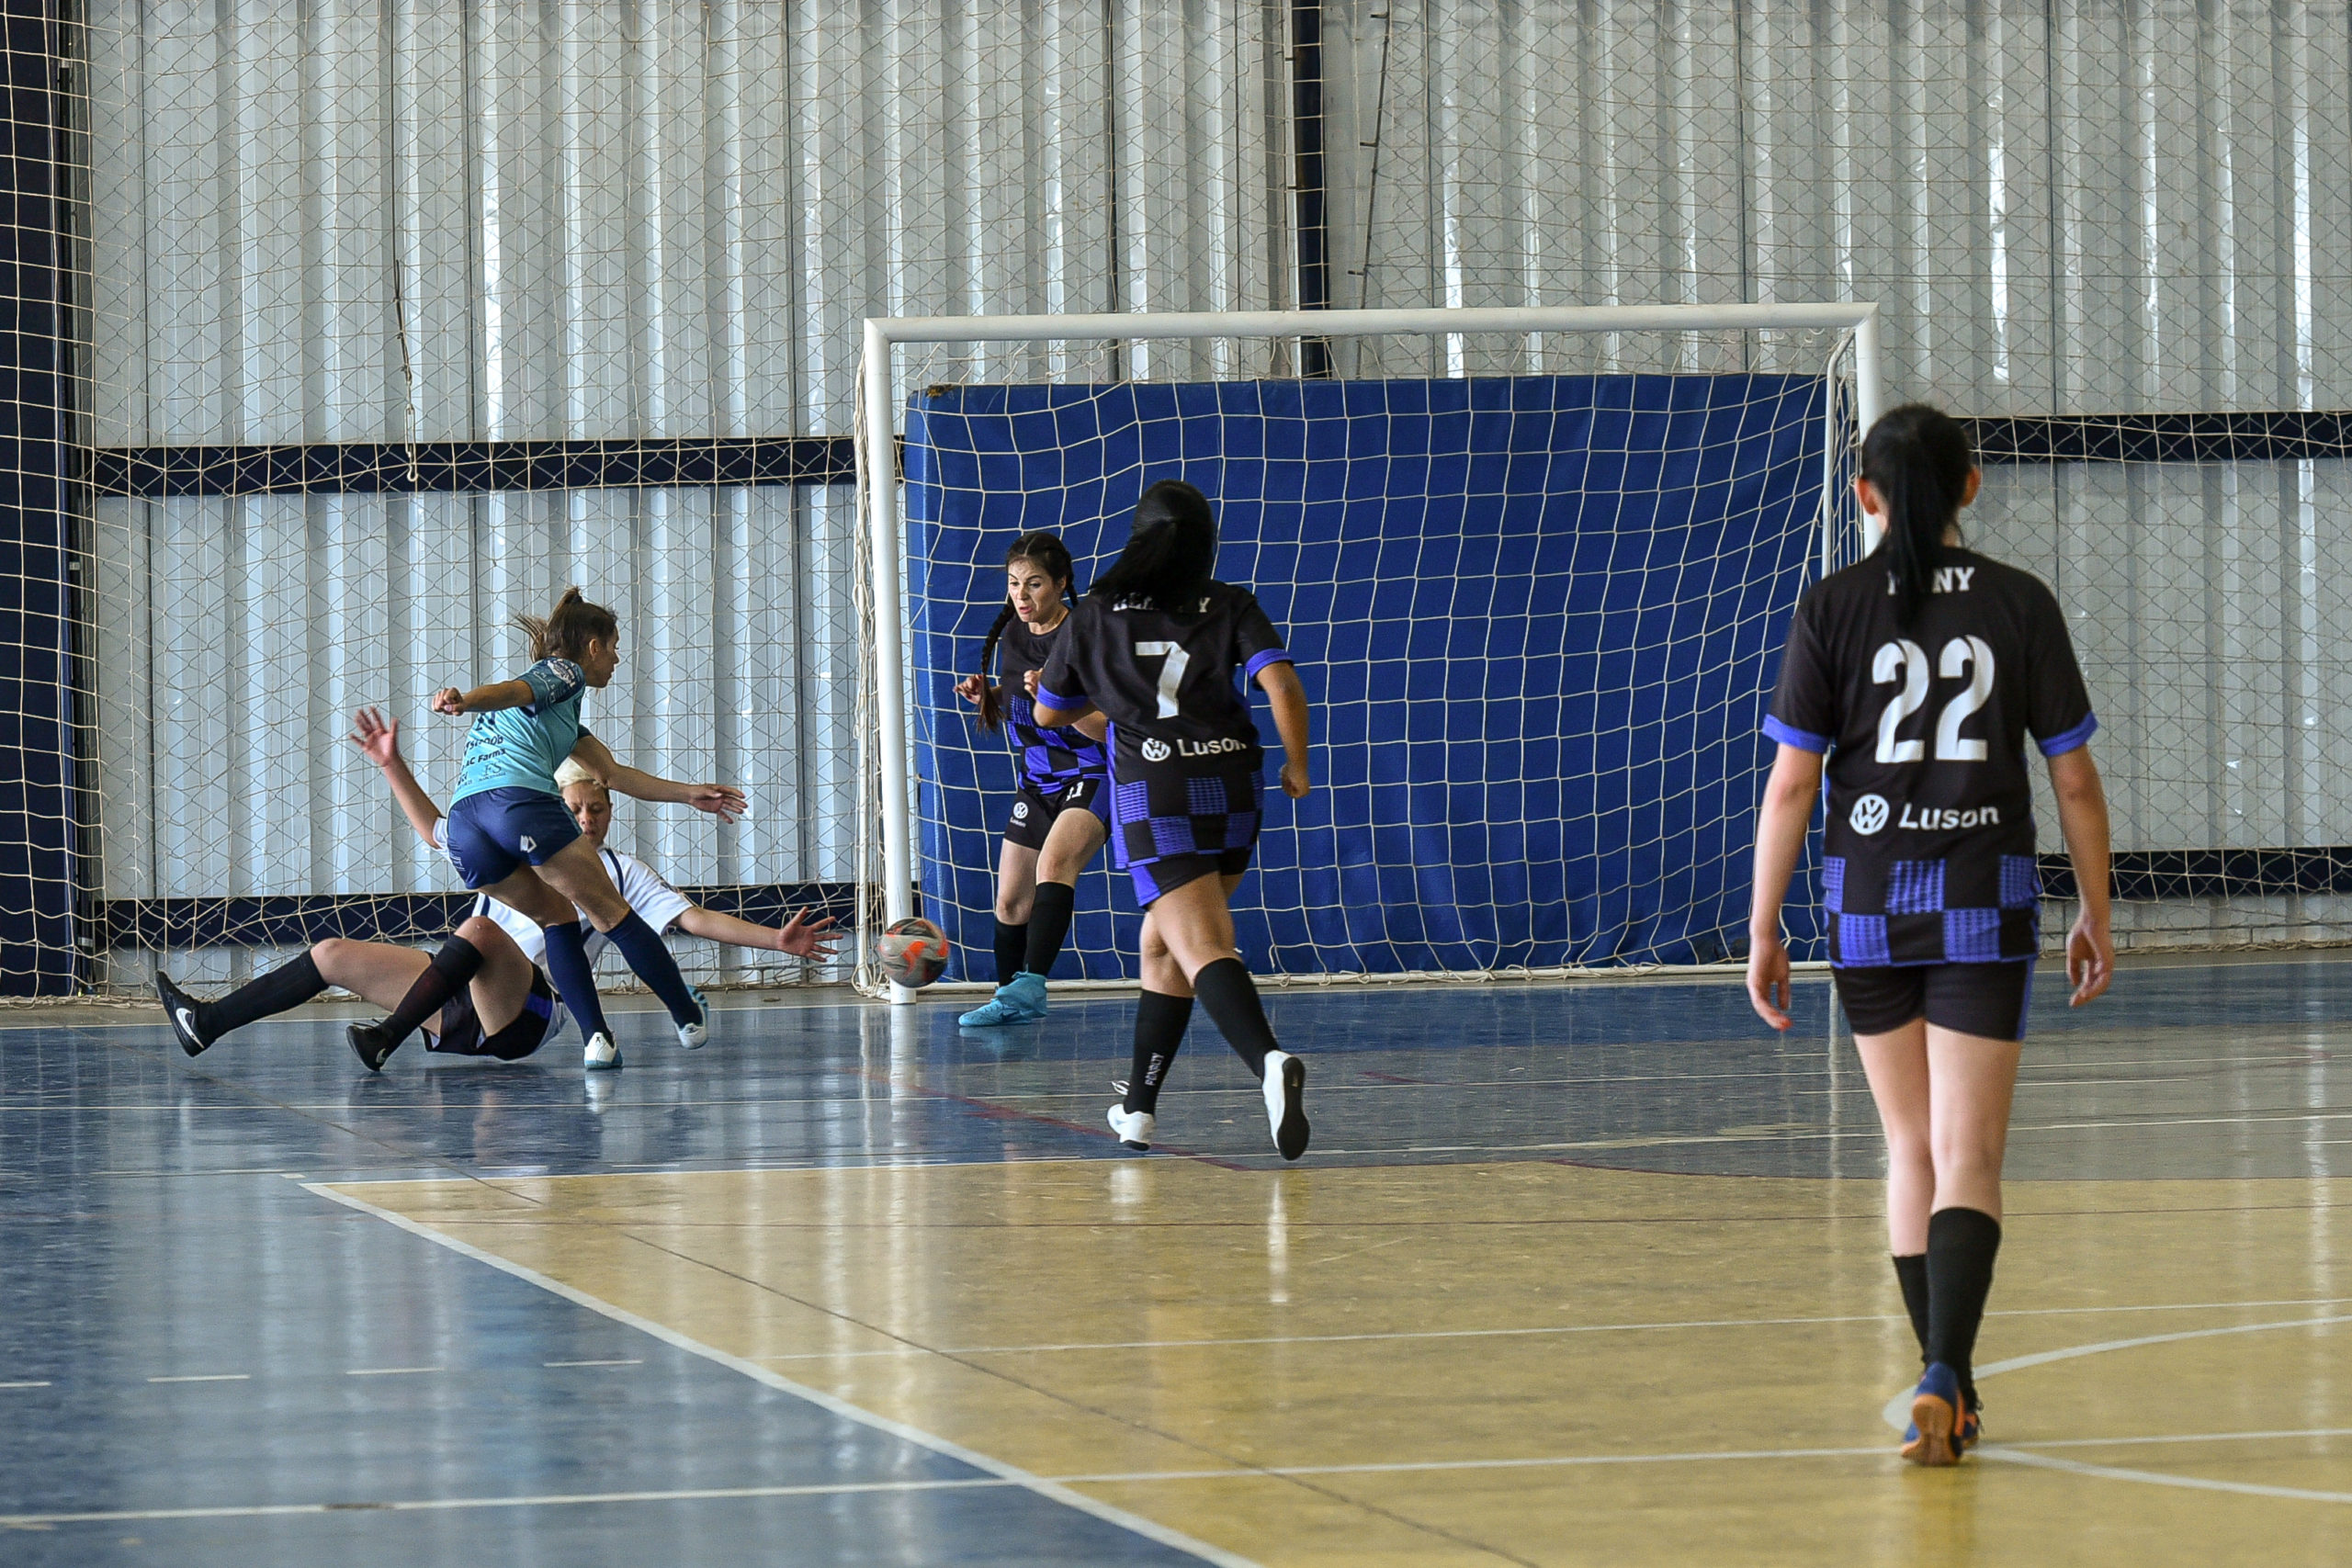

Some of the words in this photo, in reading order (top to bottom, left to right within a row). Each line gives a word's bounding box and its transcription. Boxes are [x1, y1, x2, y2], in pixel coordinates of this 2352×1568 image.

[1135, 641, 1191, 719] 7
[1872, 635, 1995, 762] 22
[1176, 737, 1248, 758] Luson
[1898, 802, 2000, 831] Luson
